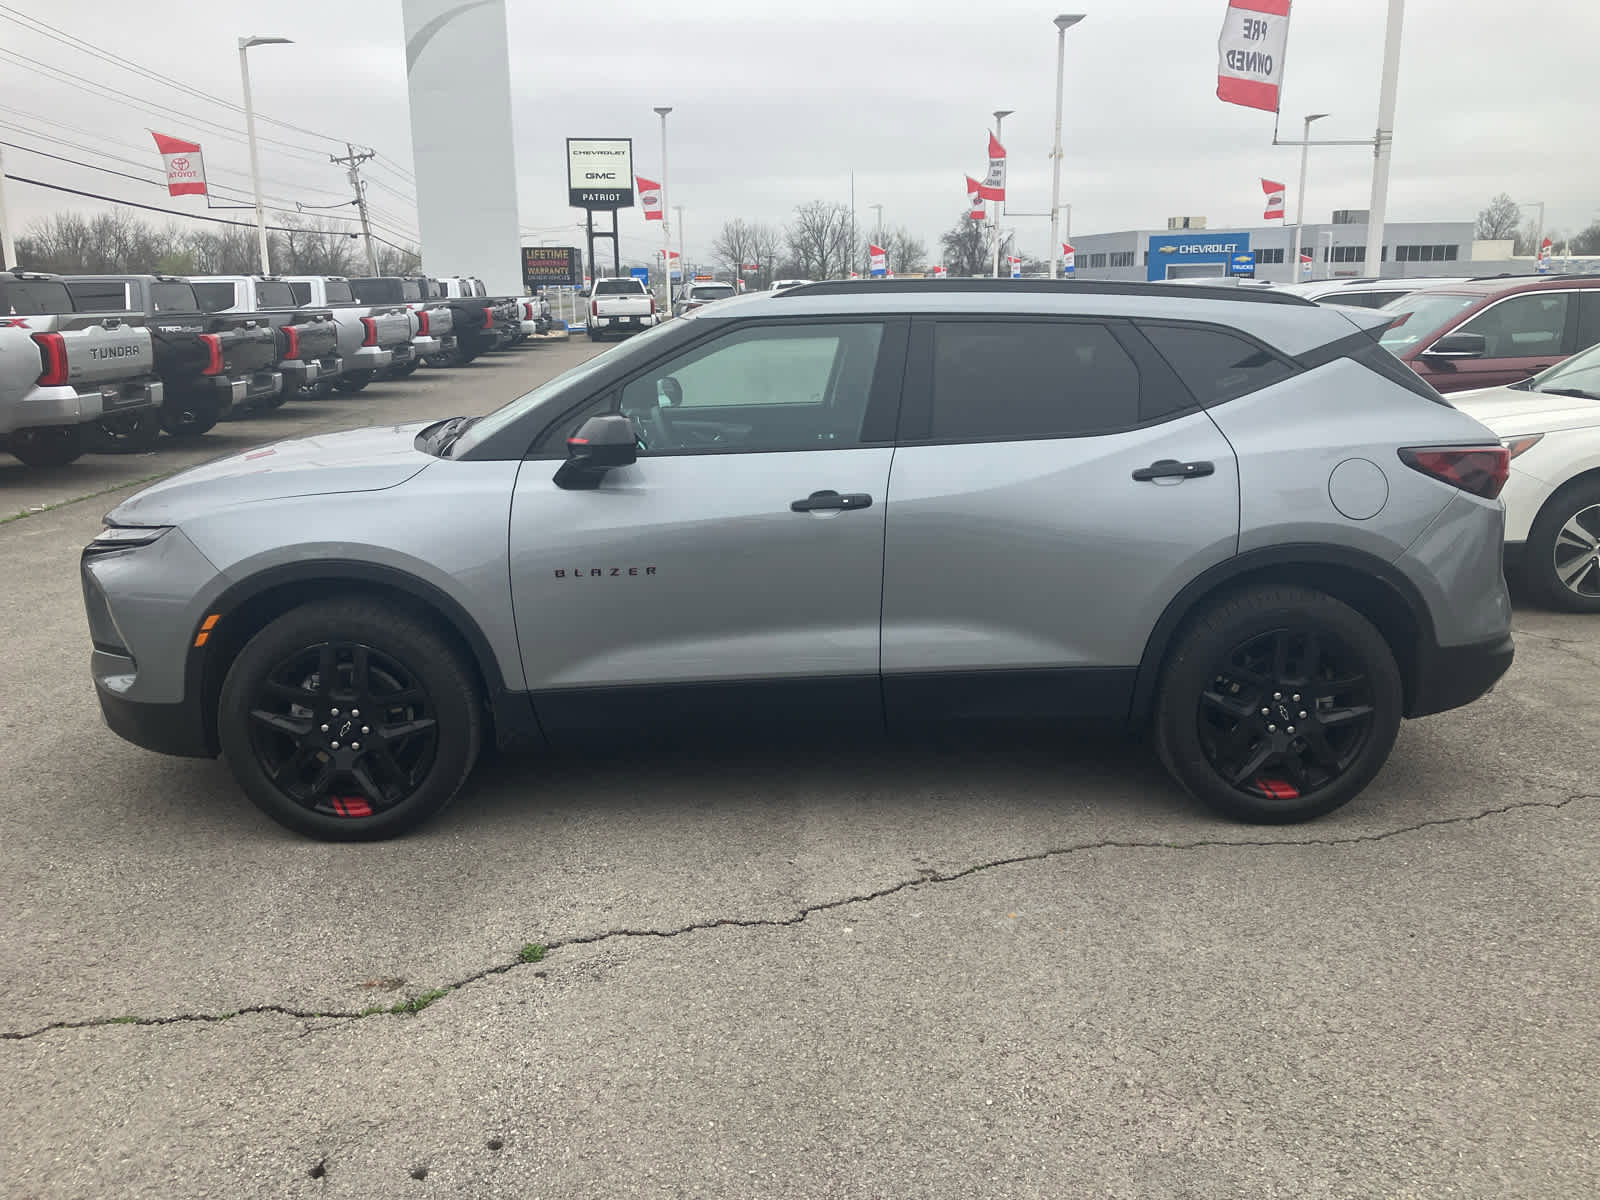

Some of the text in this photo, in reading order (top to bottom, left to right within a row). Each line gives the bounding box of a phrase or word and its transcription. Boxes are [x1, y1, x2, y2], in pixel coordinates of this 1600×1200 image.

[585, 172, 616, 180] GMC
[582, 193, 621, 201] PATRIOT
[1179, 243, 1238, 254] CHEVROLET
[527, 249, 569, 259] LIFETIME
[89, 345, 140, 360] TUNDRA
[554, 566, 657, 578] BLAZER
